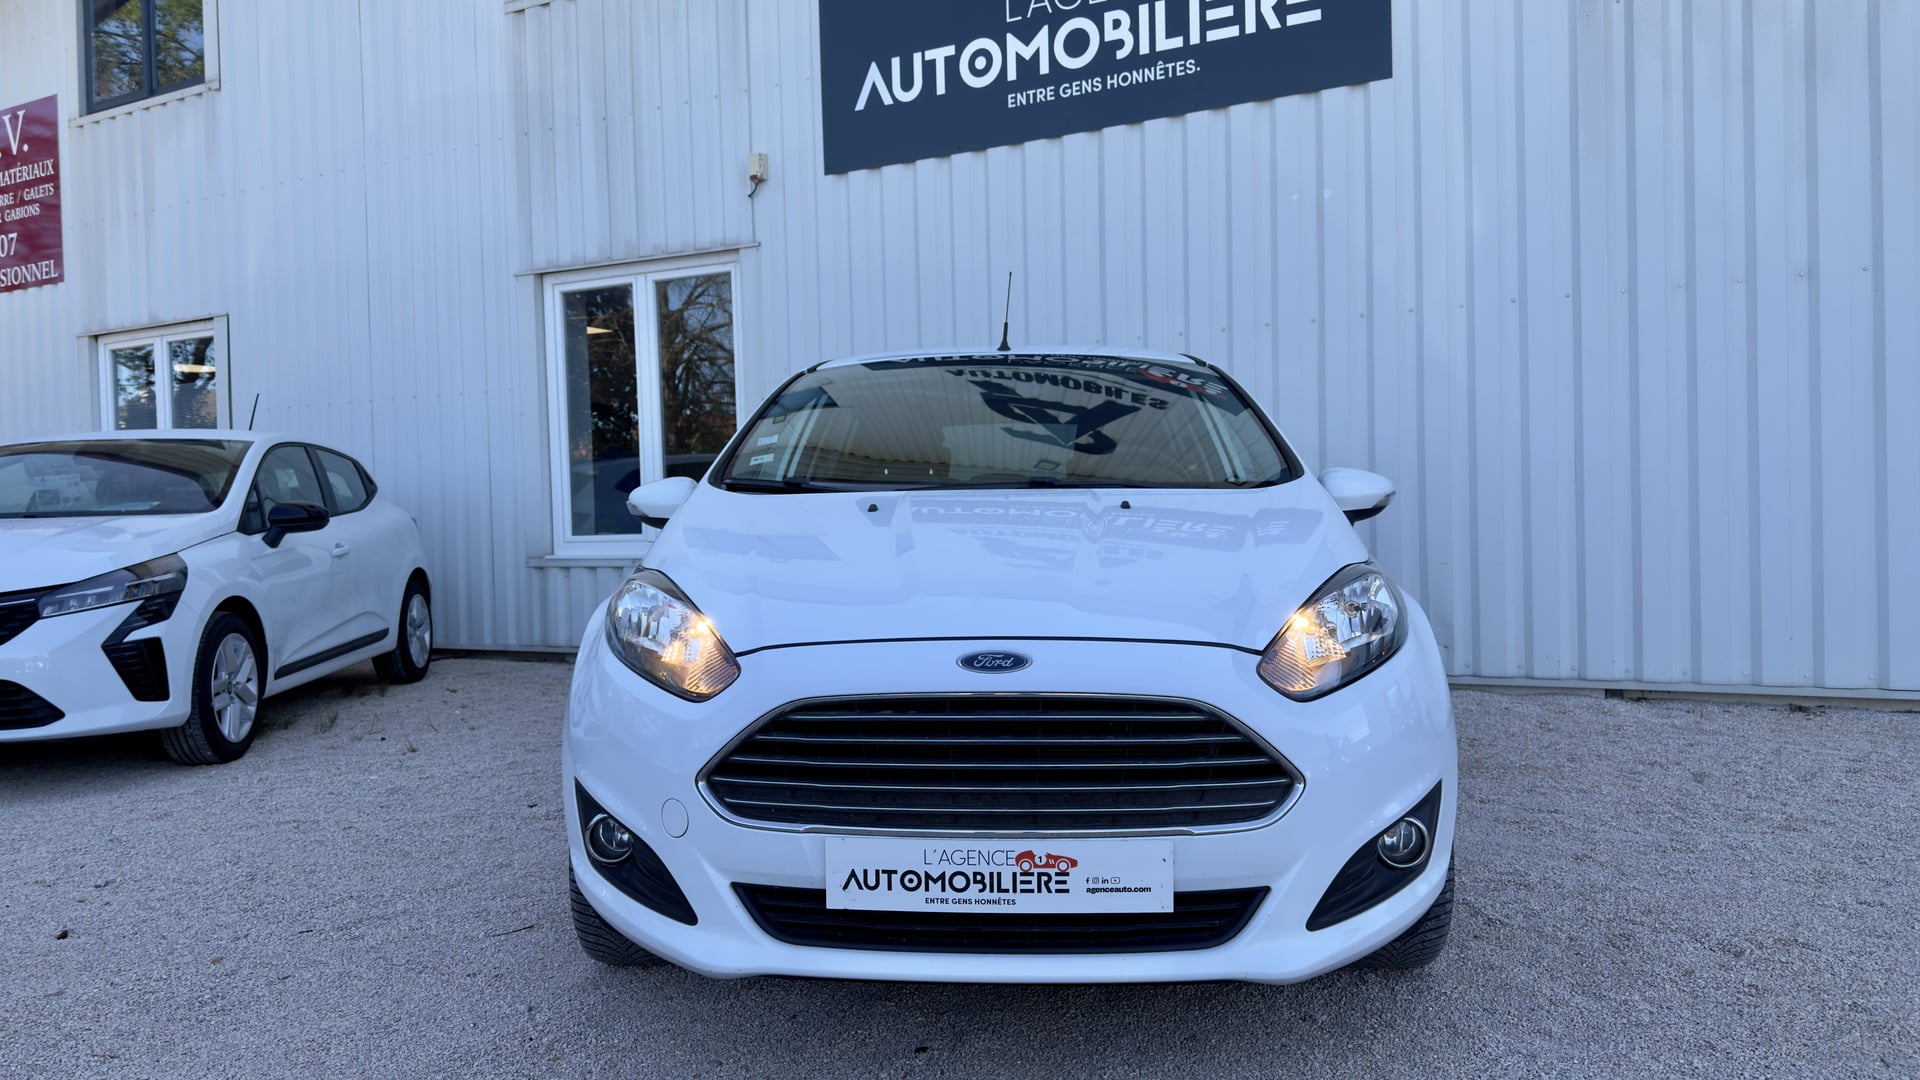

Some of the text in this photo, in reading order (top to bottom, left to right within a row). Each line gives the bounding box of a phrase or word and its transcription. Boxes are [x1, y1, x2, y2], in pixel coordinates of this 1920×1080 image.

[1007, 59, 1201, 108] ENTRE GENS HONNÊTES.
[23, 182, 55, 201] GALETS
[4, 203, 40, 222] GABIONS
[0, 232, 18, 258] 07
[0, 259, 59, 288] SIONNEL
[973, 654, 1015, 668] Ford
[923, 849, 1017, 867] L'AGENCE
[1086, 886, 1152, 895] agenceauto.com
[925, 897, 1017, 906] ENTRE GENS HONNÊTES
